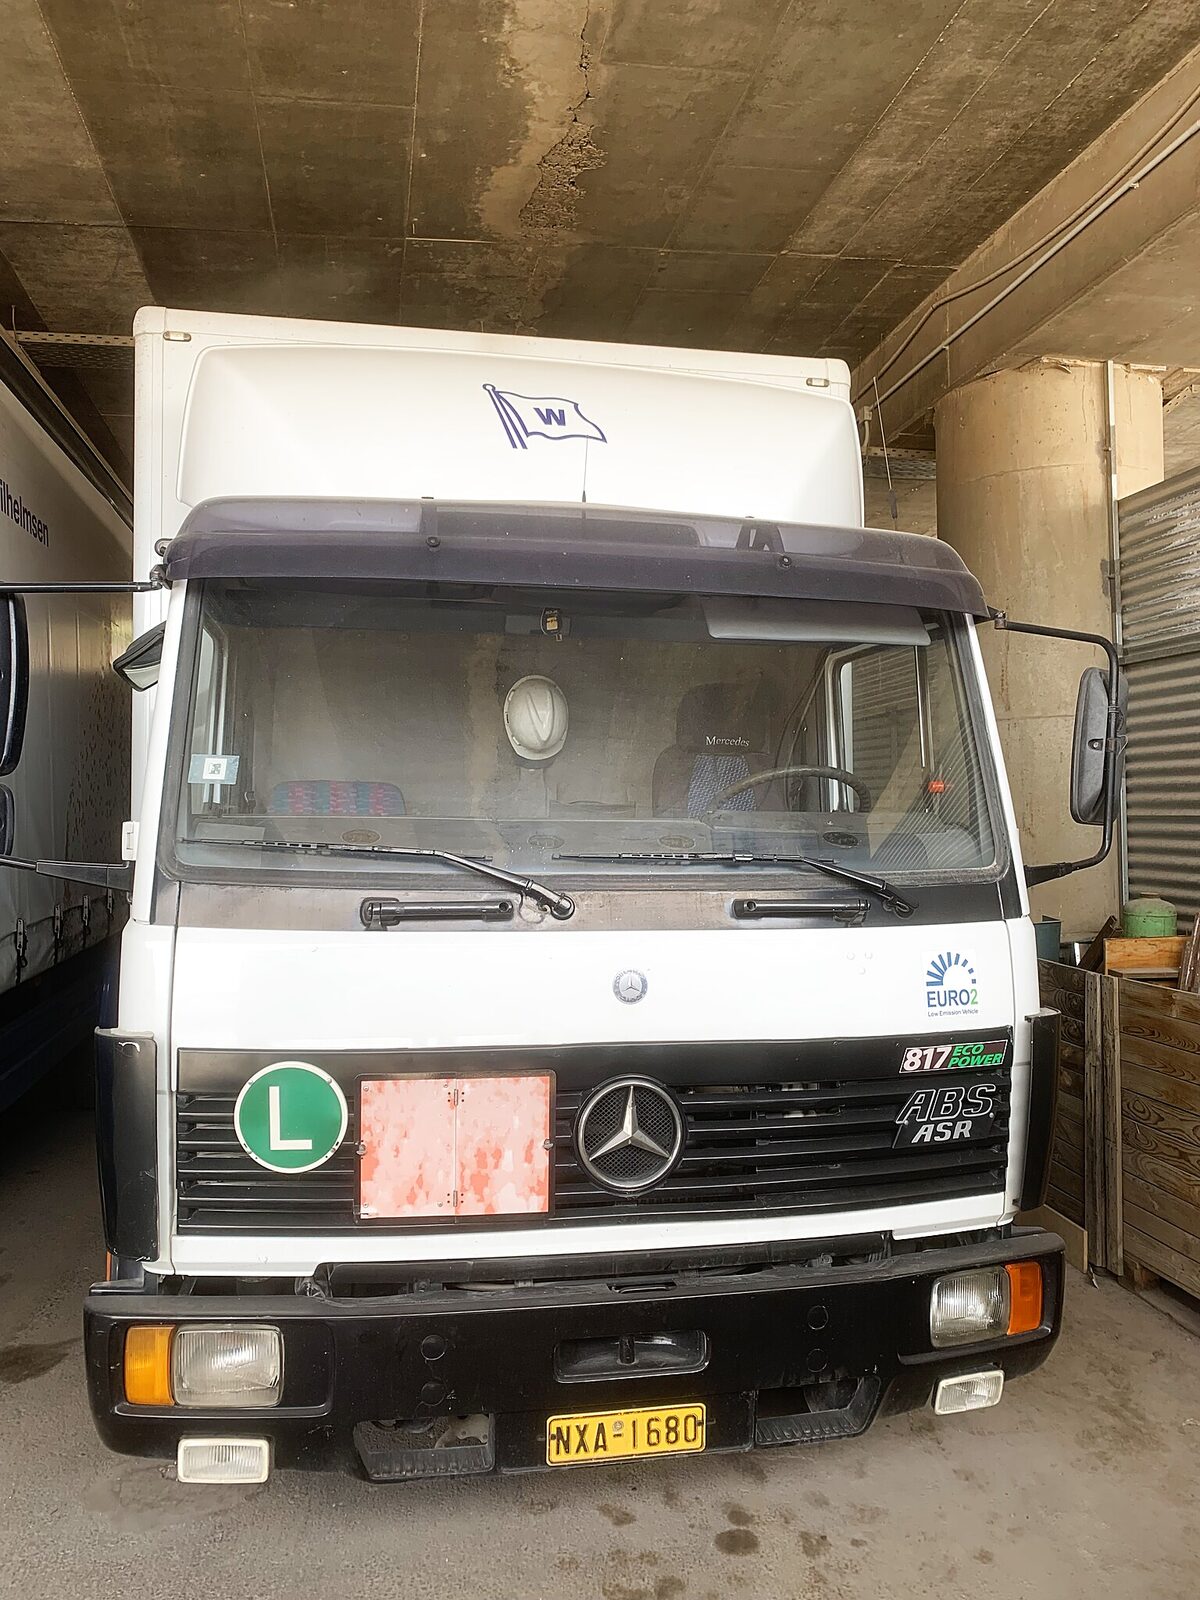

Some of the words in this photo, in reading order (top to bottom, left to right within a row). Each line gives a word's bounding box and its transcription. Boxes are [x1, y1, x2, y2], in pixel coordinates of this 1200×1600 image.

[533, 407, 566, 426] W
[706, 735, 750, 747] Mercedes
[926, 988, 979, 1008] EURO2
[903, 1046, 952, 1071] 817
[952, 1044, 985, 1057] ECO
[947, 1053, 1003, 1069] POWER
[895, 1083, 997, 1125] ABS
[268, 1085, 313, 1151] L
[911, 1120, 972, 1144] ASR
